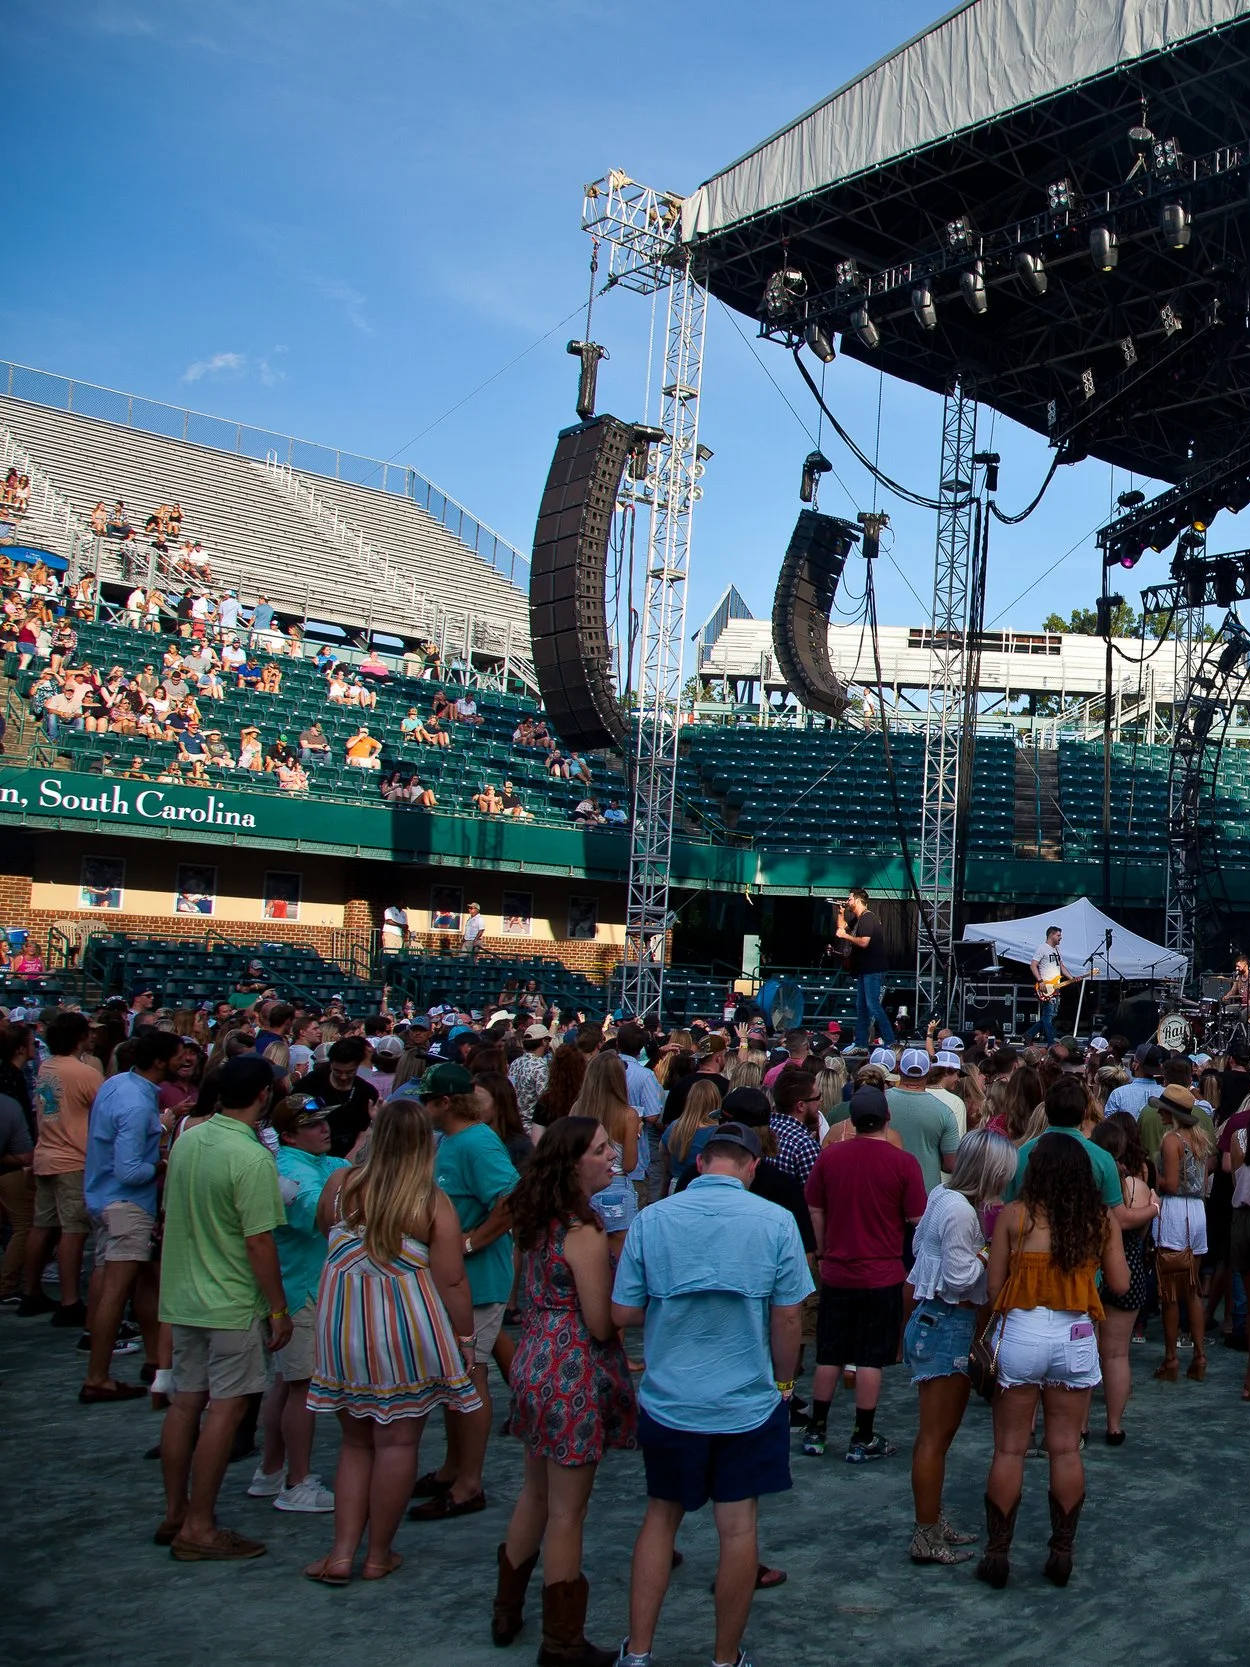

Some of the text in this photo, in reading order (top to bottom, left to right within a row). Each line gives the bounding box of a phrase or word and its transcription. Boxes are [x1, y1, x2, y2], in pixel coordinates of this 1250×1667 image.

[39, 779, 130, 815] South
[135, 790, 257, 829] Carolina
[1163, 1024, 1187, 1041] Ray
